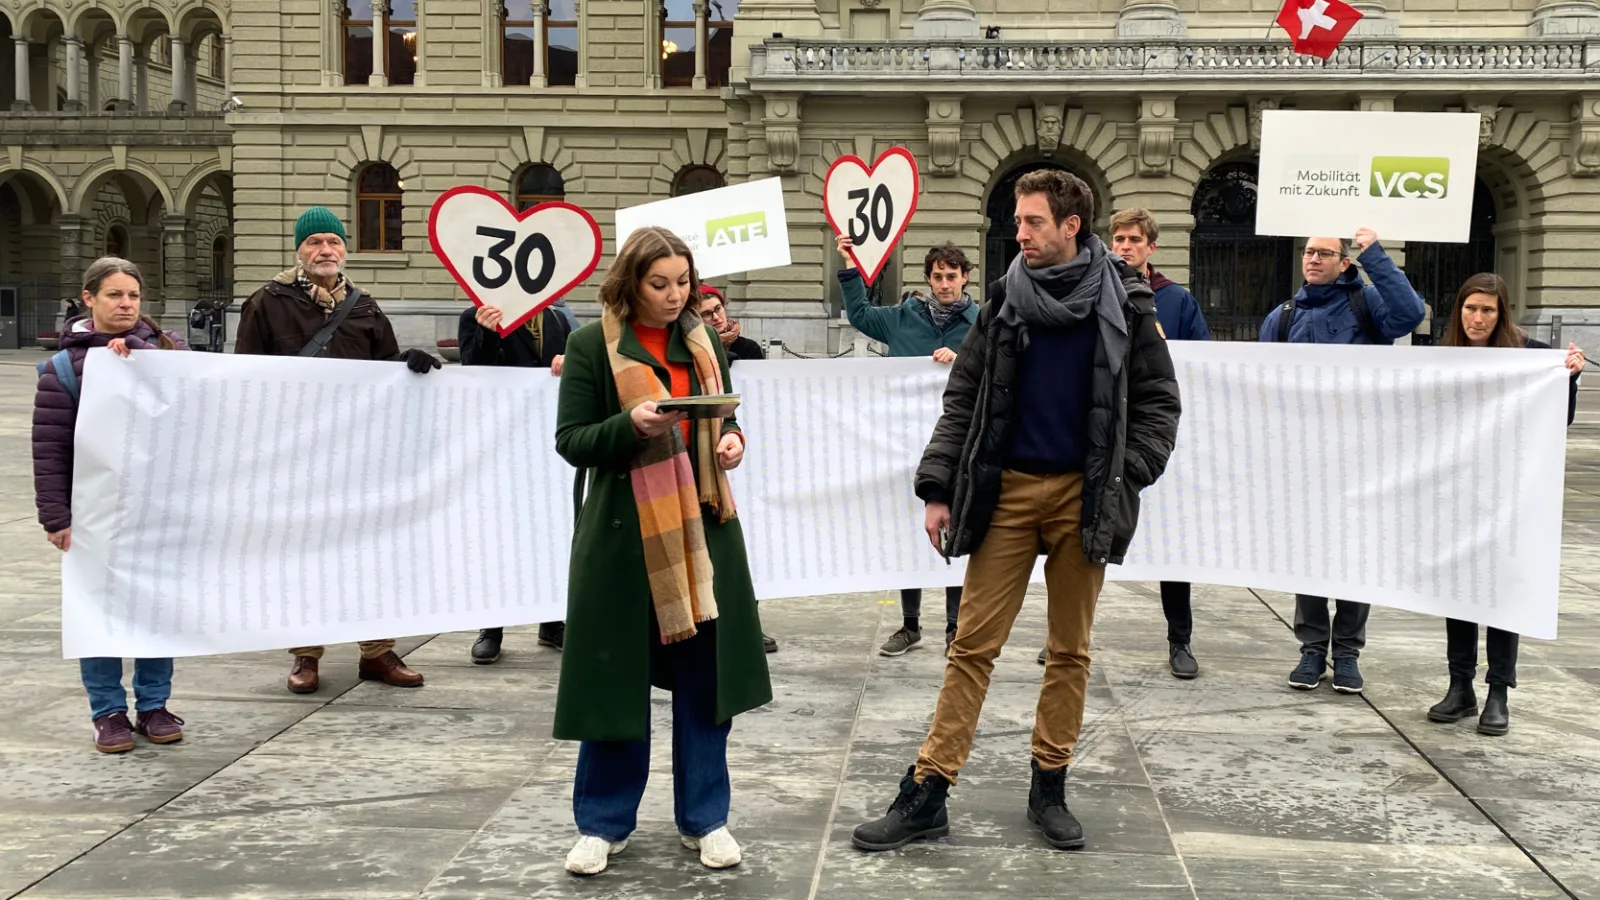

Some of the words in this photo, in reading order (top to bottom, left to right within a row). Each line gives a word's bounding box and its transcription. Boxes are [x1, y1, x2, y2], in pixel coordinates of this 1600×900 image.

[1297, 170, 1361, 182] Mobilität
[1374, 171, 1445, 199] VCS
[1279, 184, 1302, 195] mit
[1305, 184, 1360, 197] Zukunft
[848, 183, 894, 247] 30
[710, 222, 765, 249] ATE
[472, 225, 556, 295] 30
